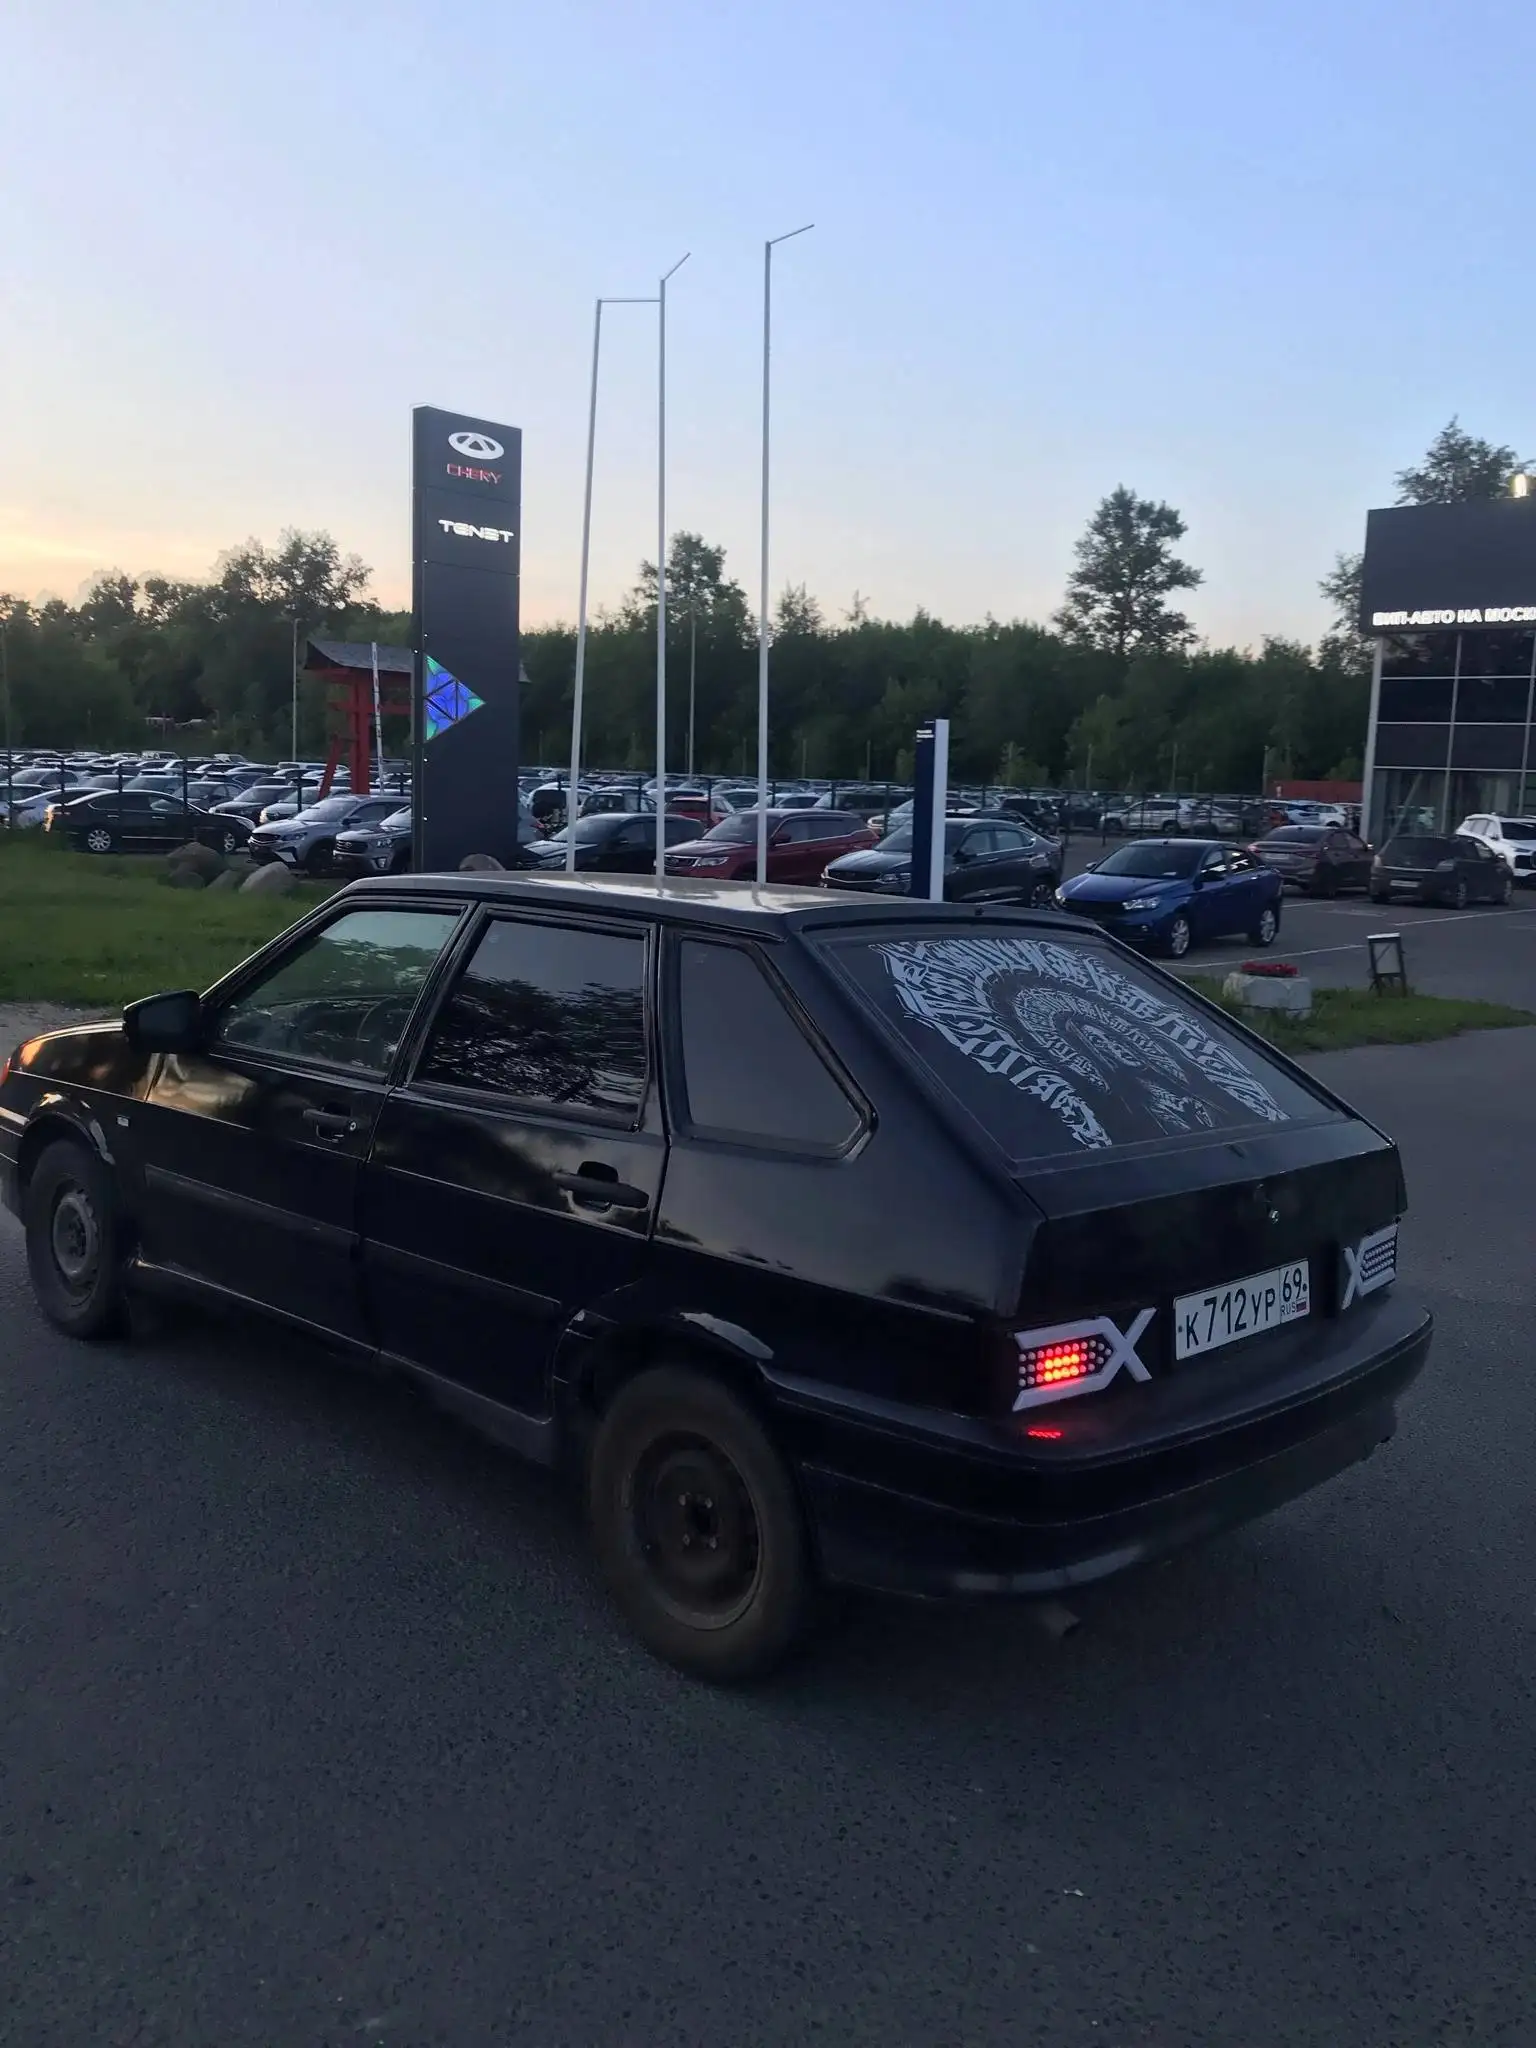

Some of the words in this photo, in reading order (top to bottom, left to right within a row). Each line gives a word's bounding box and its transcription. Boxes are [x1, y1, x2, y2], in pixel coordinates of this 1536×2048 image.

[446, 463, 502, 484] CHERY
[1457, 608, 1482, 623] НА
[1282, 1267, 1302, 1303] 69
[1280, 1303, 1297, 1317] RUS
